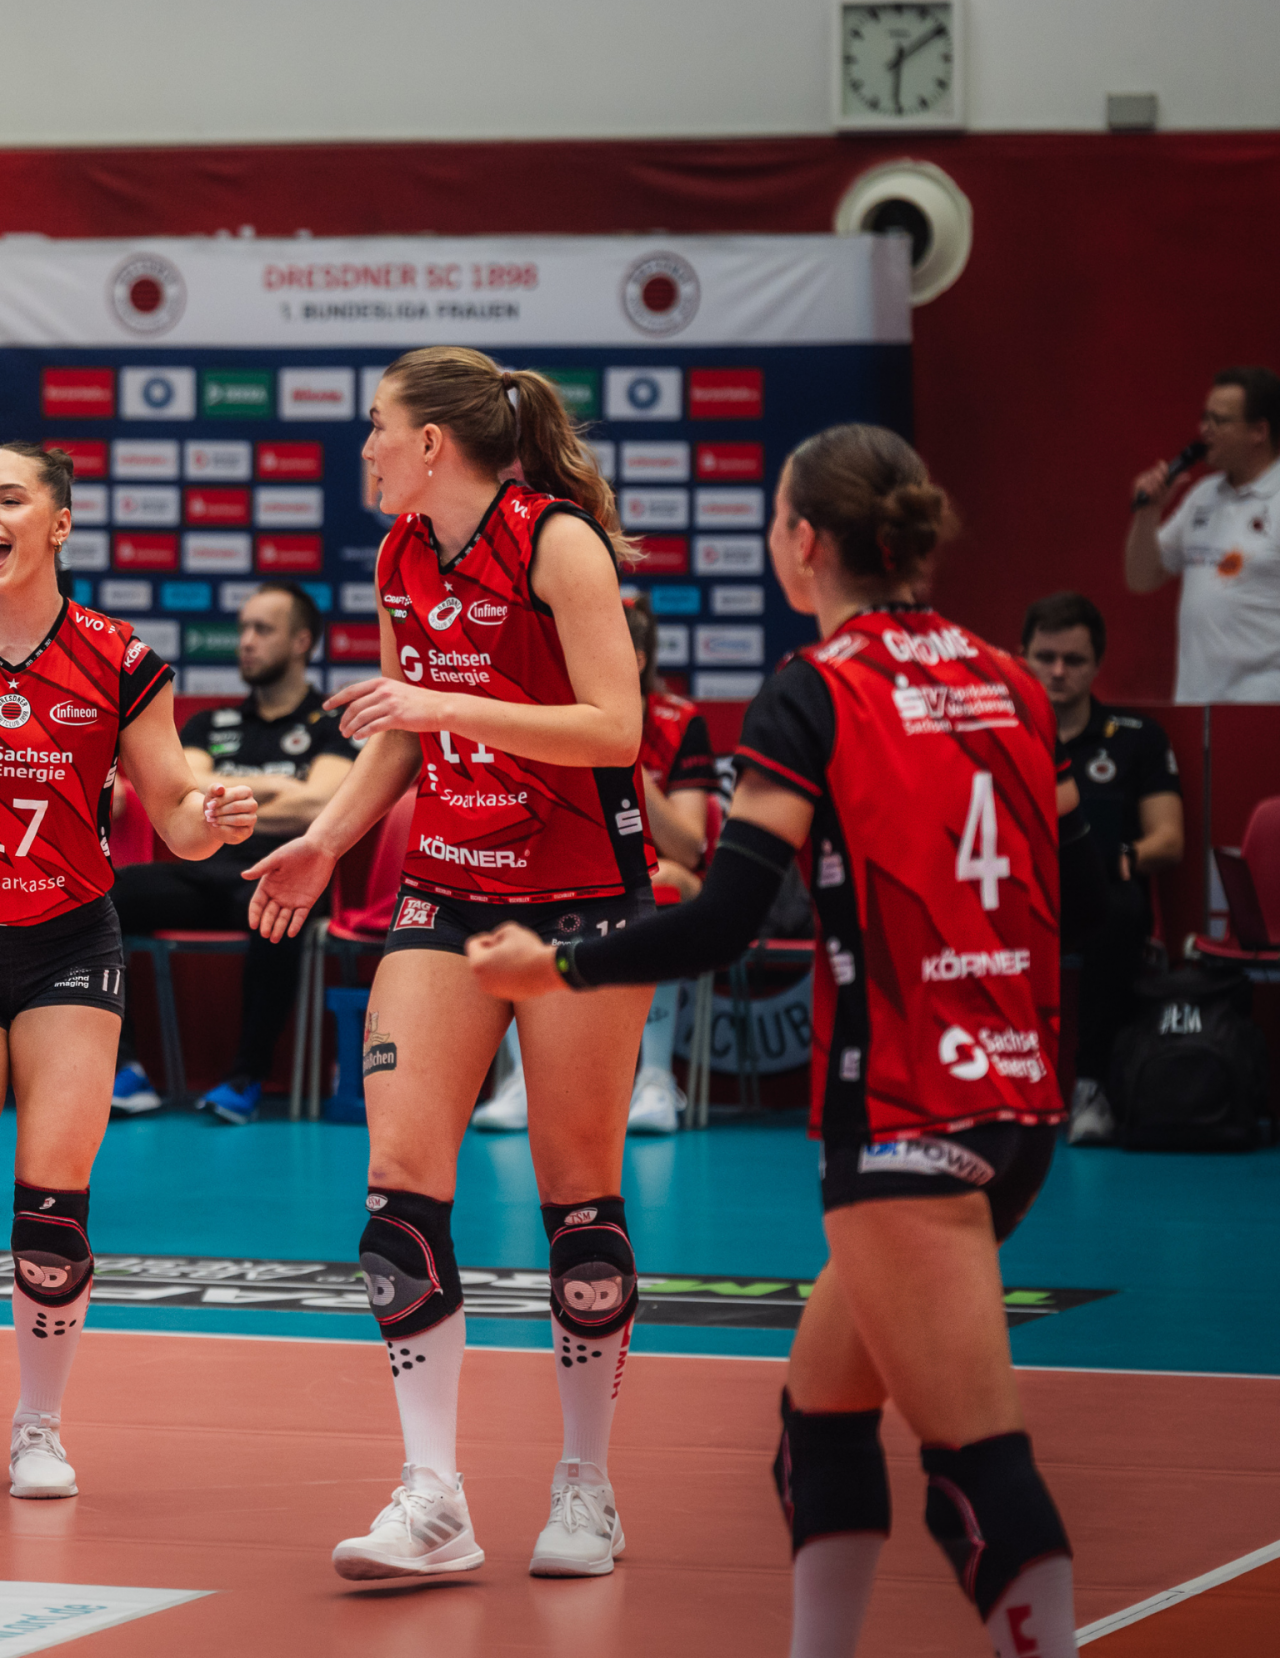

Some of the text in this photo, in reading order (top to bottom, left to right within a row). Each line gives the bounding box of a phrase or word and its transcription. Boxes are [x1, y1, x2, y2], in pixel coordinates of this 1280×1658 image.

[264, 263, 417, 290] DRESDNER
[425, 263, 462, 290] SC
[437, 302, 518, 321] FRAUEN
[75, 612, 104, 631] VVO
[428, 650, 491, 667] Sachsen
[430, 668, 490, 686] Energie
[440, 788, 528, 808] Sparkasse
[955, 770, 1010, 911] 4
[420, 835, 516, 867] KÖRNER
[406, 900, 431, 912] TAG
[400, 907, 428, 926] 24
[570, 1211, 591, 1223] TSM
